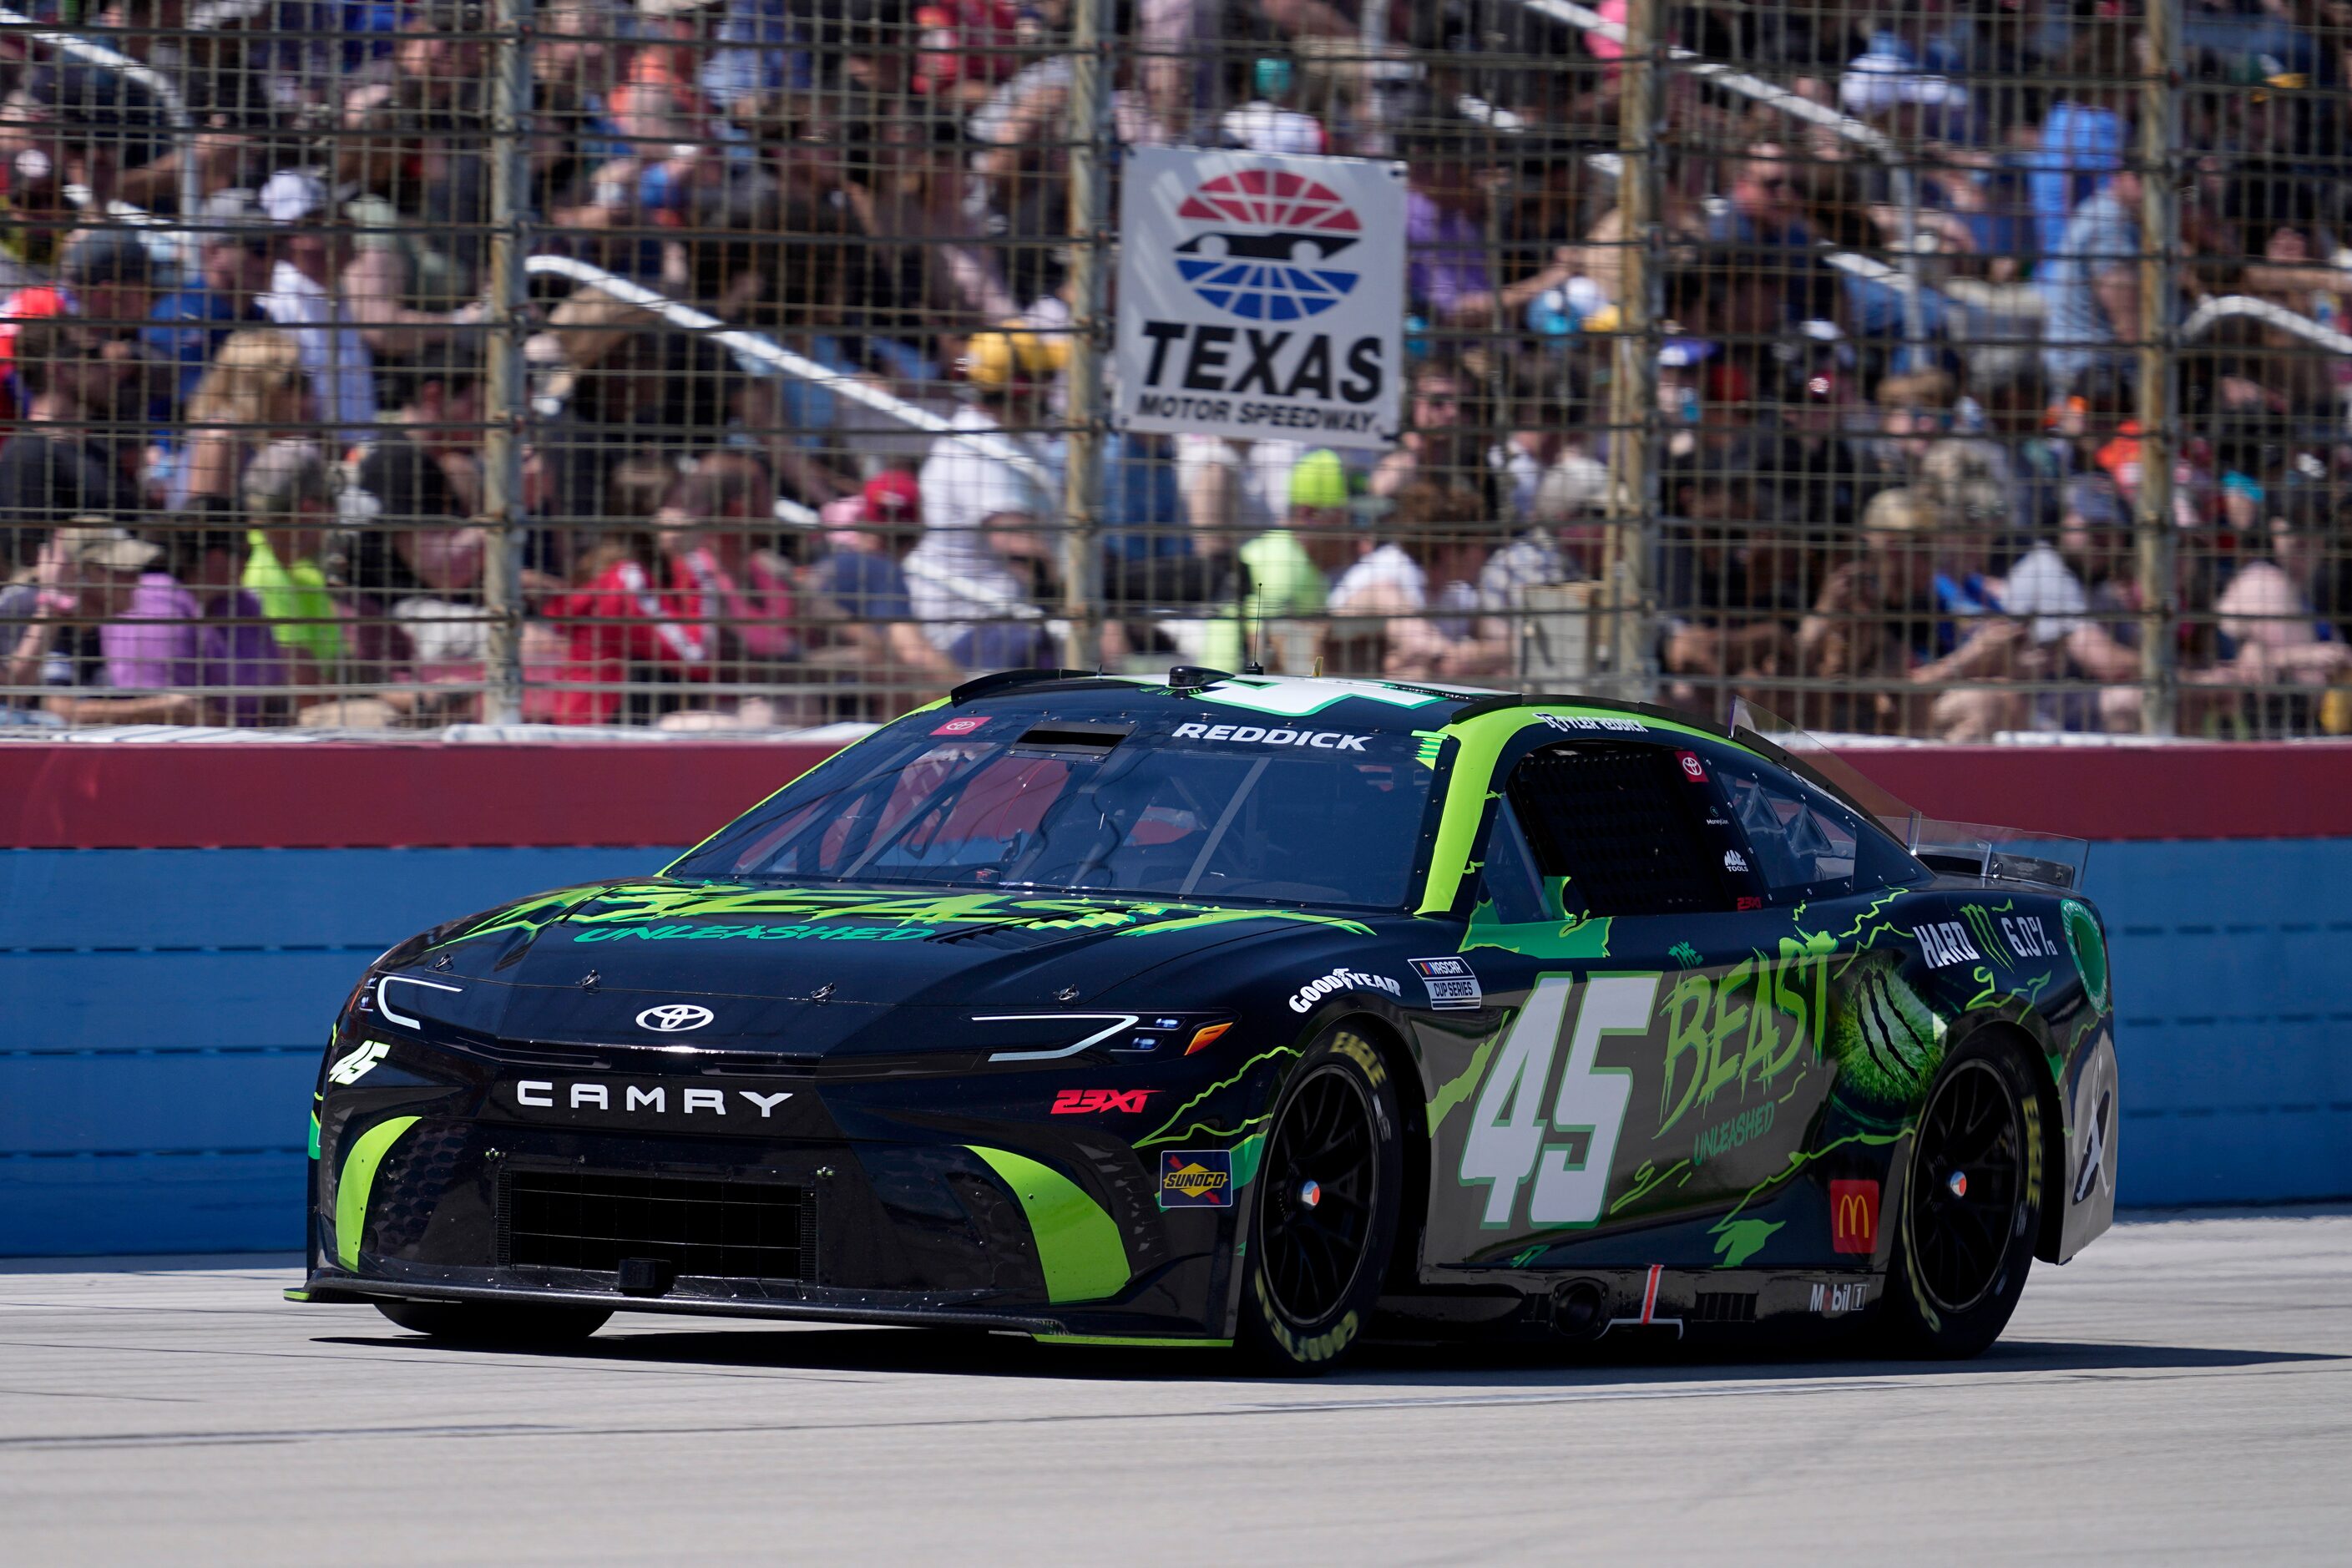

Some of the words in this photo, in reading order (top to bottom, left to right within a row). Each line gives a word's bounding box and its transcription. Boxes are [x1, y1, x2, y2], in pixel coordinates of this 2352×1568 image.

[1142, 321, 1383, 403] TEXAS
[1137, 393, 1233, 423] MOTOR
[1236, 401, 1378, 432] SPEEDWAY
[1171, 722, 1373, 751] REDDICK
[574, 925, 937, 943] UNLEASHED
[1912, 921, 1981, 969] HARD
[2000, 916, 2059, 958] 6.0%
[1429, 960, 1464, 974] NASCAR
[1288, 969, 1402, 1014] GOODYEAR
[1433, 982, 1448, 997] CUP
[1448, 981, 1474, 997] SERIES
[1652, 925, 1839, 1140] BEAST
[328, 1039, 391, 1085] 45
[517, 1079, 794, 1118] CAMRY
[1459, 970, 1664, 1229] 45
[1693, 1101, 1775, 1166] UNLEASHED
[1166, 1173, 1226, 1187] SUNOCO
[1809, 1283, 1852, 1312] Mobil
